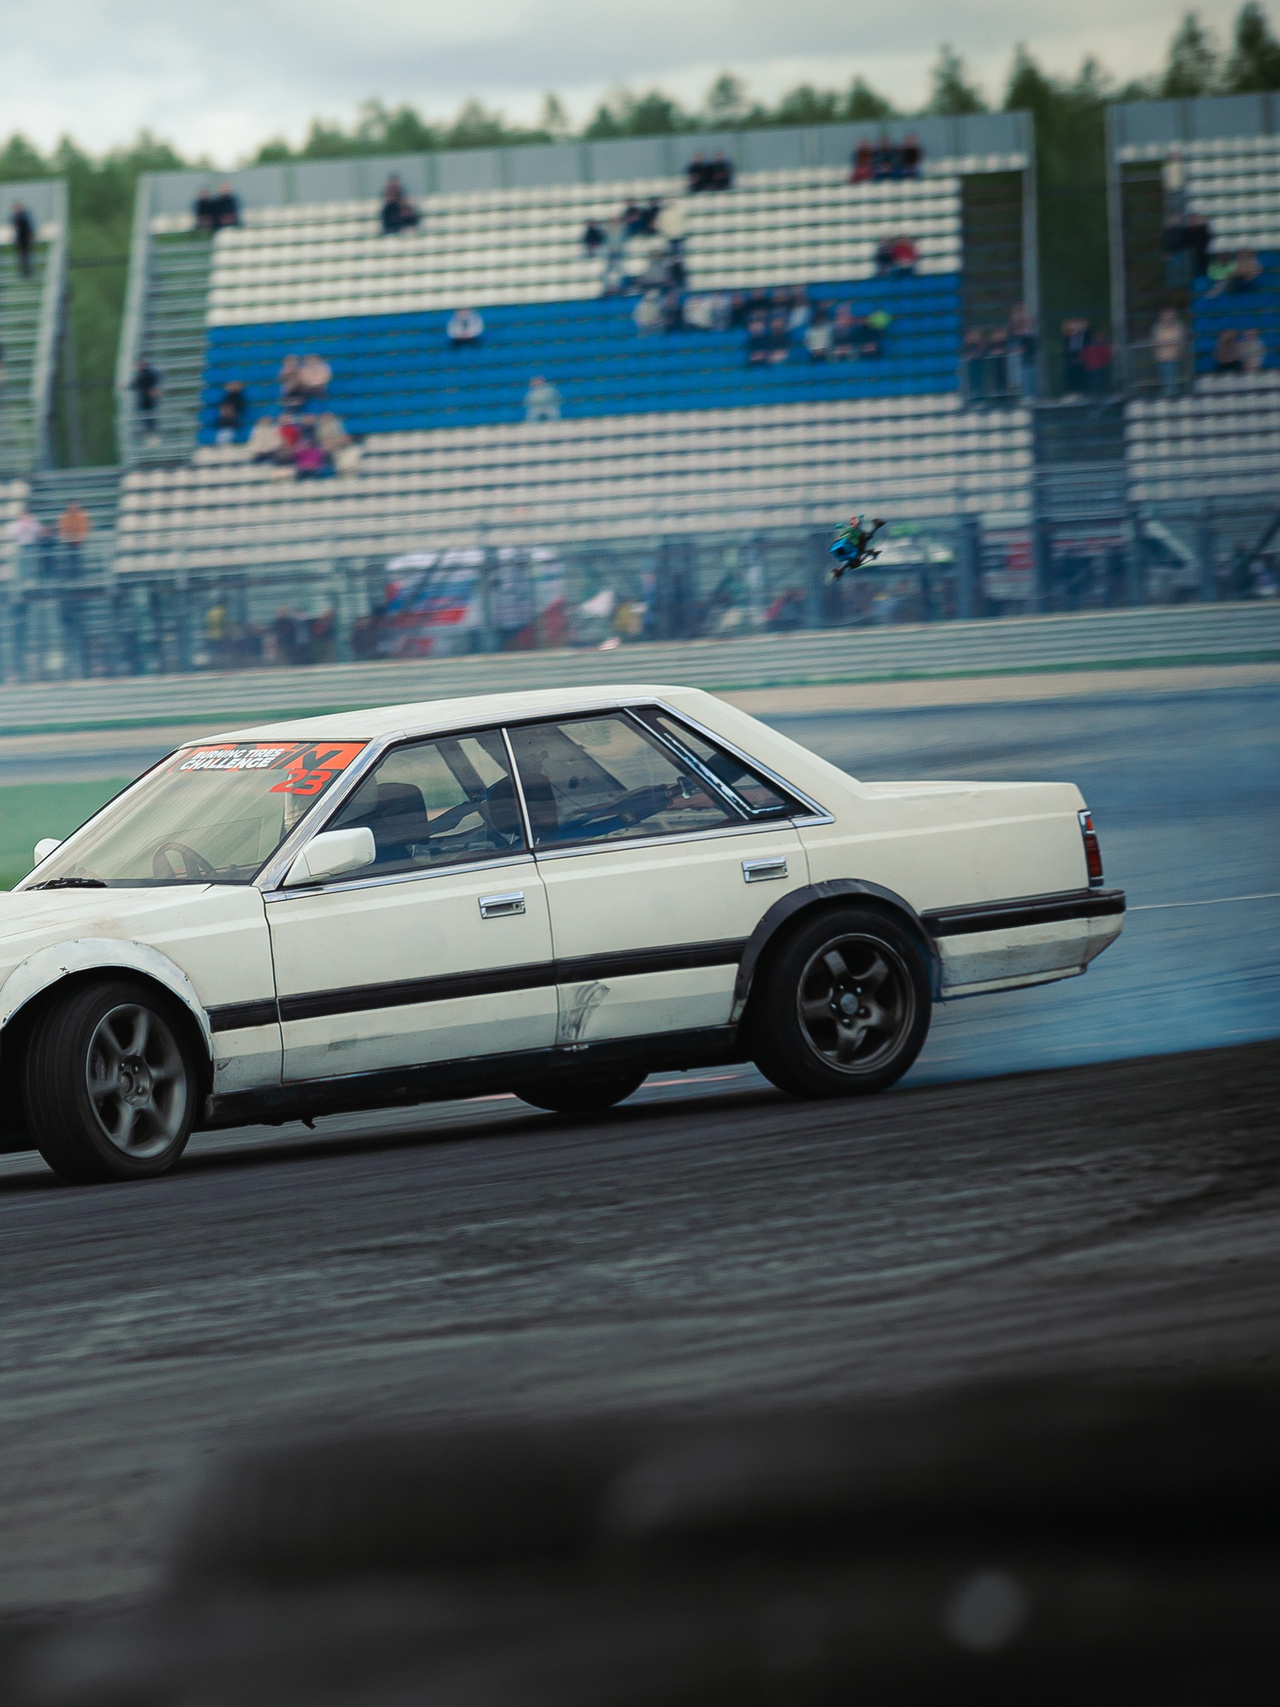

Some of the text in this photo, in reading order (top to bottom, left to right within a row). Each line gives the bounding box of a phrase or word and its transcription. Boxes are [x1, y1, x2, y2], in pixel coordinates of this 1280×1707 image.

[191, 748, 285, 760] BURNING TIRES
[180, 757, 276, 770] CHALLENGE
[269, 768, 332, 795] 23
